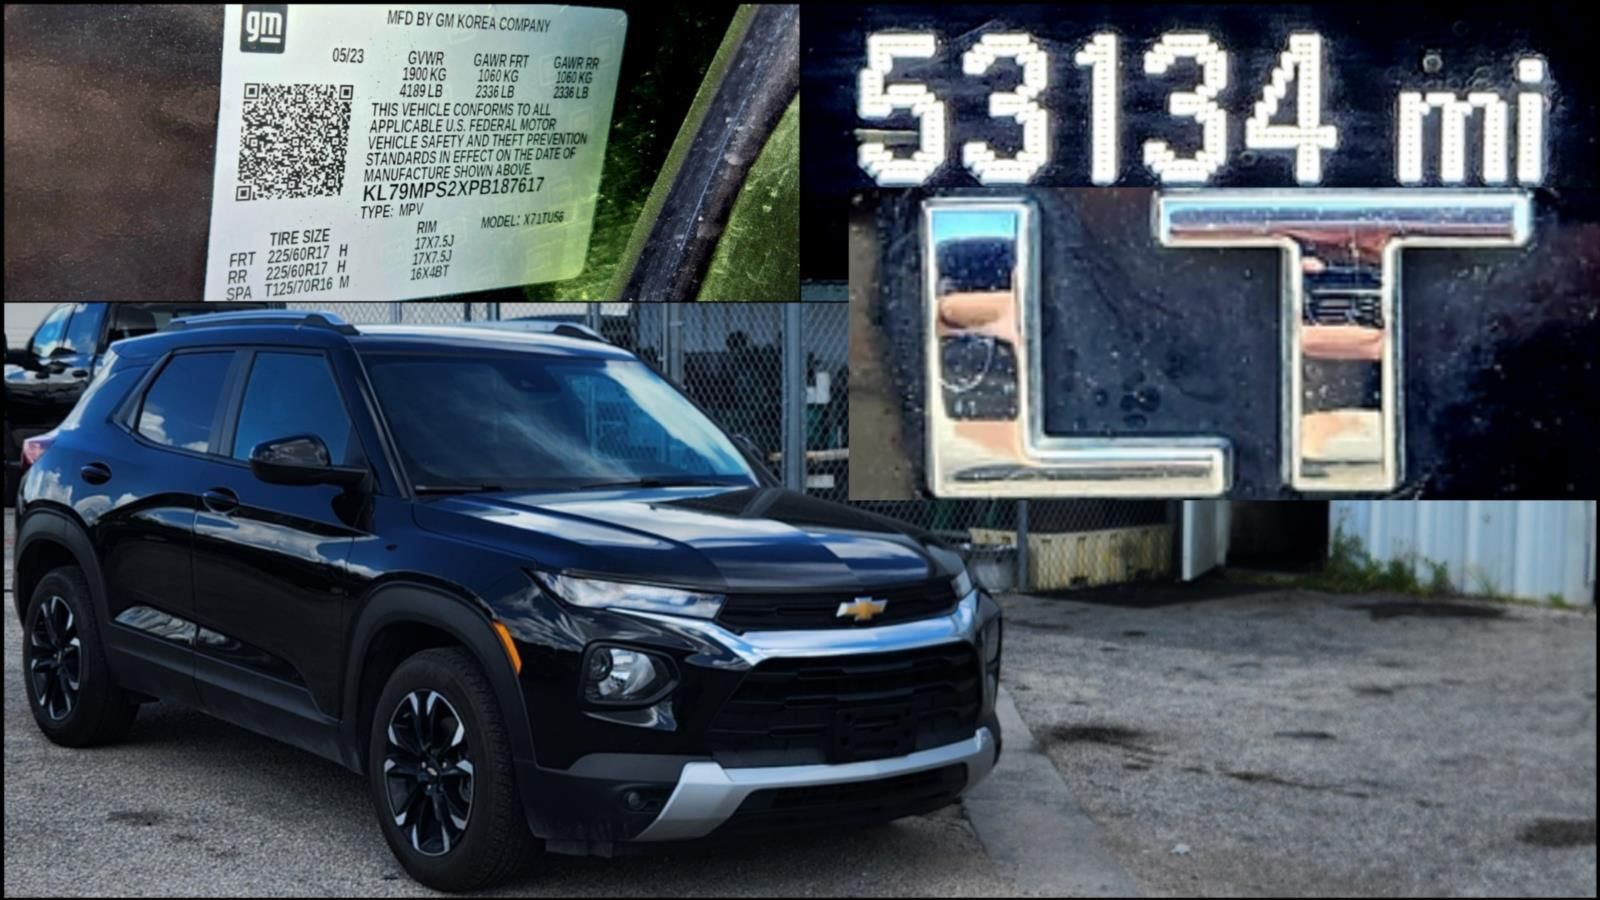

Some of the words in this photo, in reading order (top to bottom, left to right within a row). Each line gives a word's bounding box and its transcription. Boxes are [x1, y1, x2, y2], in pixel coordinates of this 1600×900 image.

[246, 11, 282, 43] gm
[387, 9, 414, 26] MFD
[416, 11, 434, 27] BY
[435, 13, 455, 28] GM
[457, 14, 496, 30] KOREA
[499, 16, 551, 33] COMPANY
[332, 47, 364, 64] 05/23
[408, 50, 444, 66] GVWR
[473, 53, 507, 68] GAWR
[509, 54, 530, 68] FRT
[553, 56, 583, 70] GAWR
[585, 57, 600, 70] RR
[402, 67, 428, 82] 1900
[429, 67, 447, 82] KG
[478, 69, 501, 83] 1060
[503, 69, 519, 83] KG
[556, 71, 577, 84] 1060
[578, 71, 593, 84] KG
[399, 83, 426, 98] 4189
[427, 83, 443, 98] LB
[475, 85, 500, 99] 2336
[501, 85, 515, 99] LB
[553, 86, 575, 99] 2336
[576, 86, 589, 99] LB
[372, 102, 399, 117] THIS
[402, 102, 451, 117] VEHICLE
[453, 103, 514, 117] CONFORMS
[517, 103, 531, 116] TO
[532, 103, 552, 116] ALL
[857, 33, 1337, 186] 53134
[1399, 58, 1544, 184] mi
[369, 119, 444, 134] APPLICABLE
[445, 118, 467, 133] U.S.
[469, 118, 517, 132] FEDERAL
[519, 118, 557, 132] MOTOR
[368, 135, 418, 150] VEHICLE
[420, 134, 465, 149] SAFETY
[466, 133, 490, 148] AND
[492, 133, 525, 147] THEFT
[526, 132, 589, 146] PREVENTION
[365, 150, 437, 166] STANDARDS
[439, 150, 451, 163] IN
[453, 148, 494, 163] EFFECT
[495, 148, 512, 162] ON
[514, 148, 534, 161] THE
[535, 147, 562, 160] DATE
[562, 146, 577, 159] OF
[363, 165, 451, 182] MANUFACTURE
[453, 164, 494, 179] SHOWN
[362, 176, 545, 202] KL79MPS2XPB187617
[360, 203, 394, 219] TYPE:
[399, 202, 424, 217] MPV
[416, 220, 437, 234] RIM
[480, 214, 520, 229] MODEL:
[270, 230, 300, 246] TIRE
[302, 228, 331, 244] SIZE
[414, 234, 455, 250] 17X7.5J
[229, 251, 257, 268] FRT
[267, 245, 330, 264] 225/60R17
[339, 243, 348, 257] H
[412, 249, 452, 266] 17X7.5J
[227, 269, 248, 285] RR
[265, 261, 328, 281] 225/60R17
[337, 259, 346, 274] H
[410, 264, 449, 281] 16X4BT
[226, 286, 252, 301] SPA
[264, 277, 333, 297] T125/70R16
[339, 275, 350, 288] M
[921, 190, 1533, 499] LT
